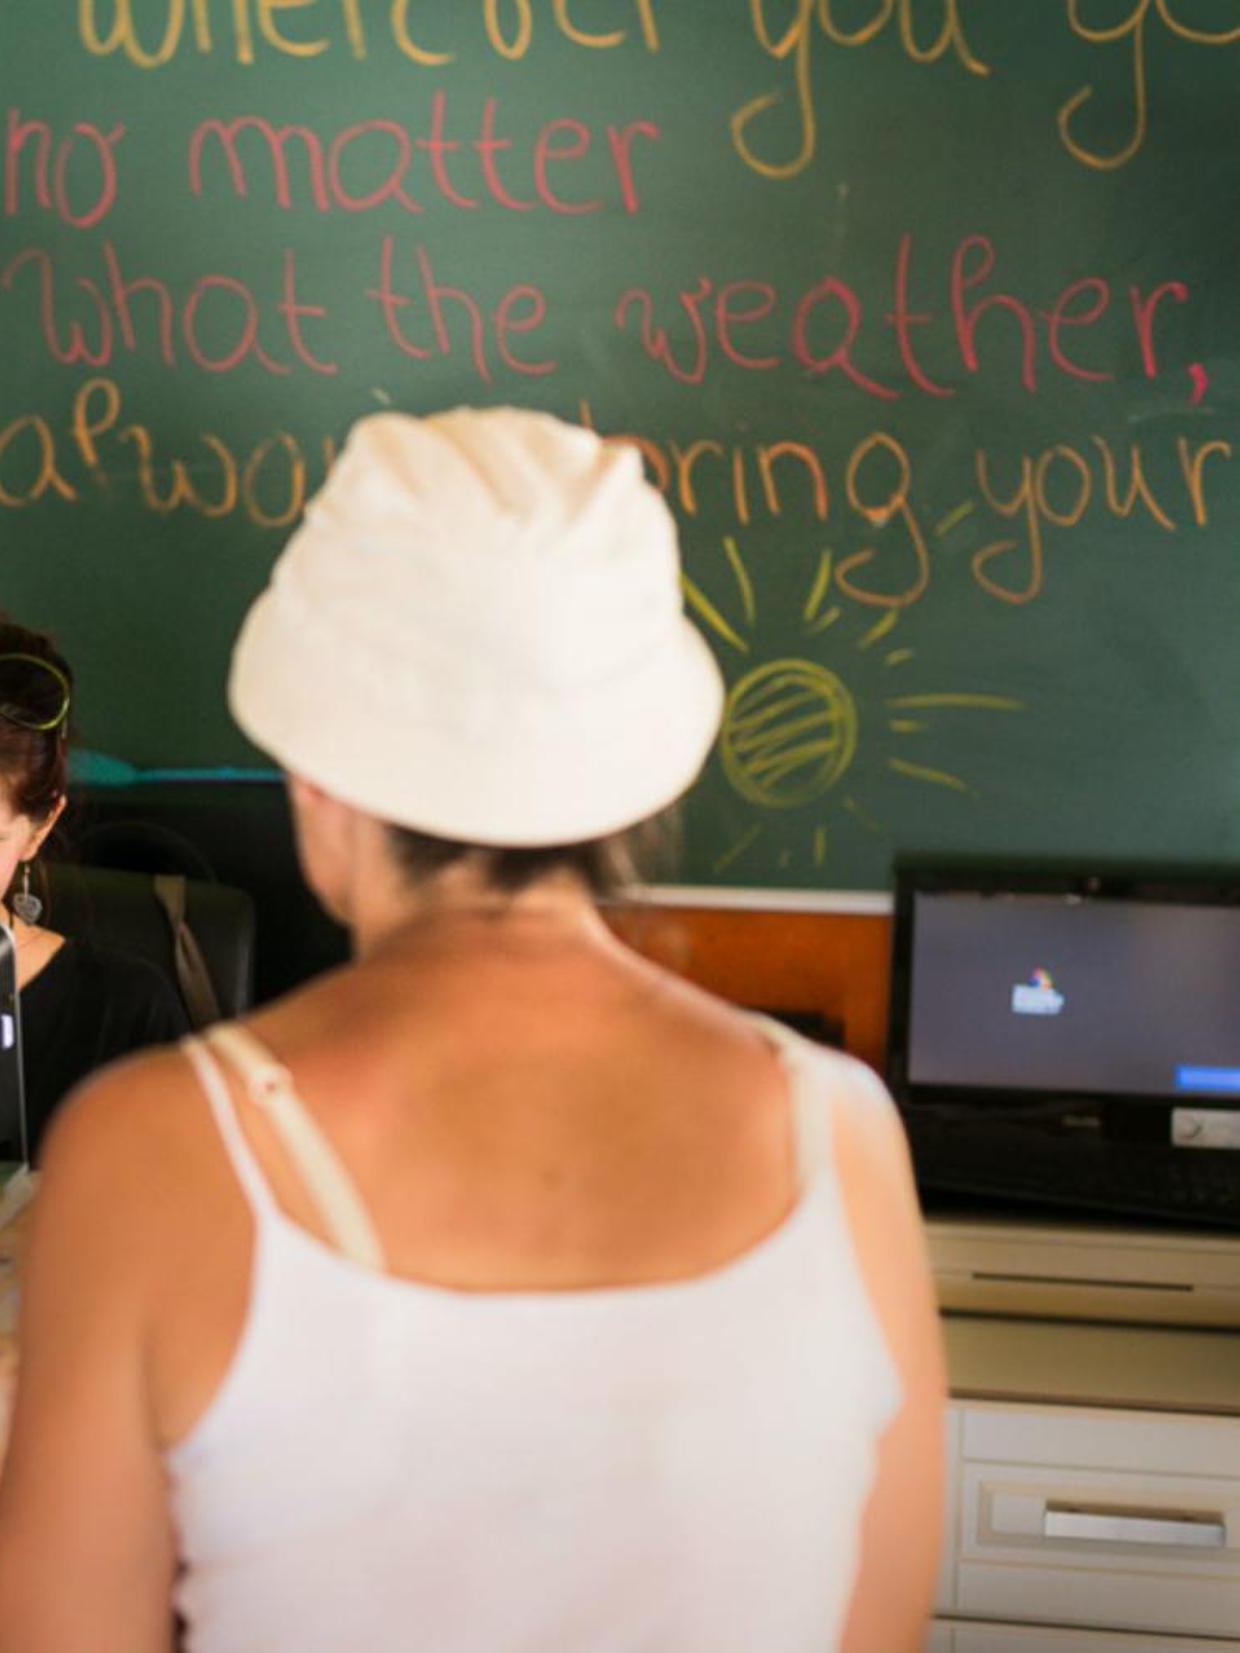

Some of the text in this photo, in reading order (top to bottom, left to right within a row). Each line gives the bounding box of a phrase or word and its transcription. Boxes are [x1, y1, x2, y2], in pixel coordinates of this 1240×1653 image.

[4, 89, 659, 228] no matter
[0, 233, 1209, 405] what the weather,
[972, 434, 1234, 604] your
